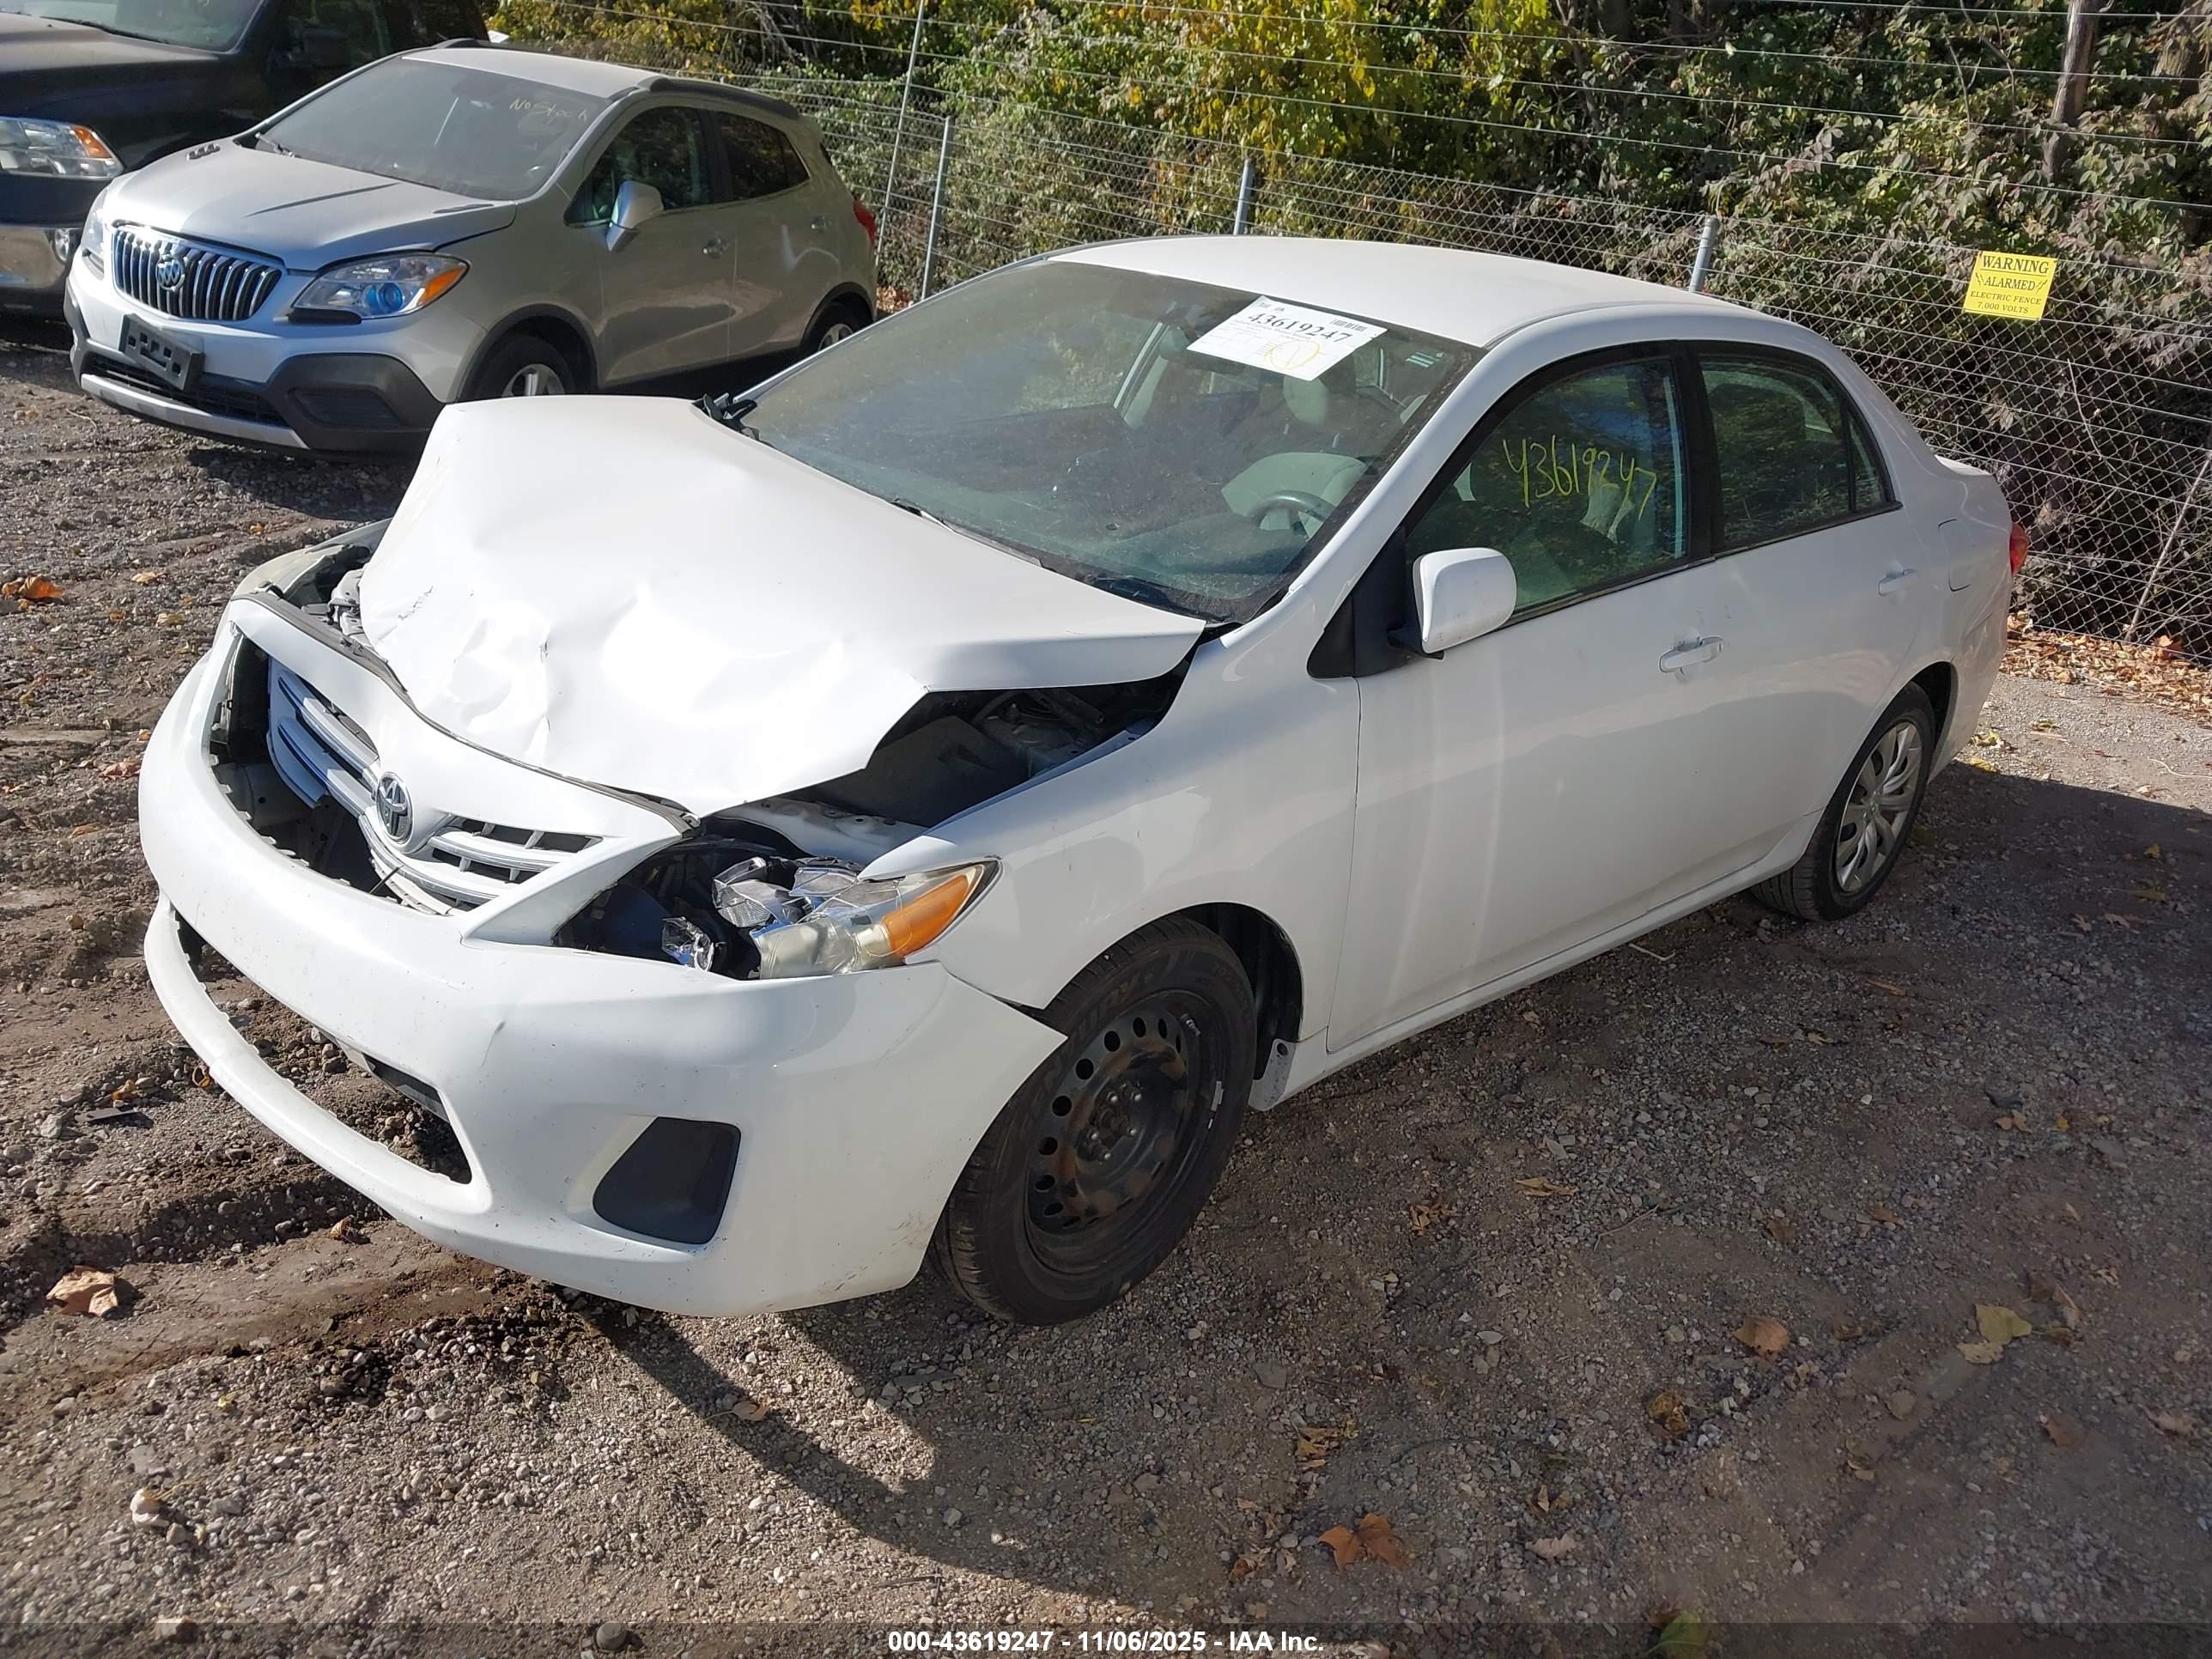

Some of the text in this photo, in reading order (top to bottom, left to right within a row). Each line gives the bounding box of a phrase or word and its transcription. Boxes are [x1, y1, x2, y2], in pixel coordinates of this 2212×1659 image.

[1983, 255, 2050, 274] WARNING
[1984, 276, 2036, 291] ALARMED
[1970, 290, 2042, 306] ELECTRIC FENCE
[2002, 304, 2029, 314] VOLTS
[1247, 311, 1353, 343] 43619247
[1503, 434, 1657, 522] 43619247
